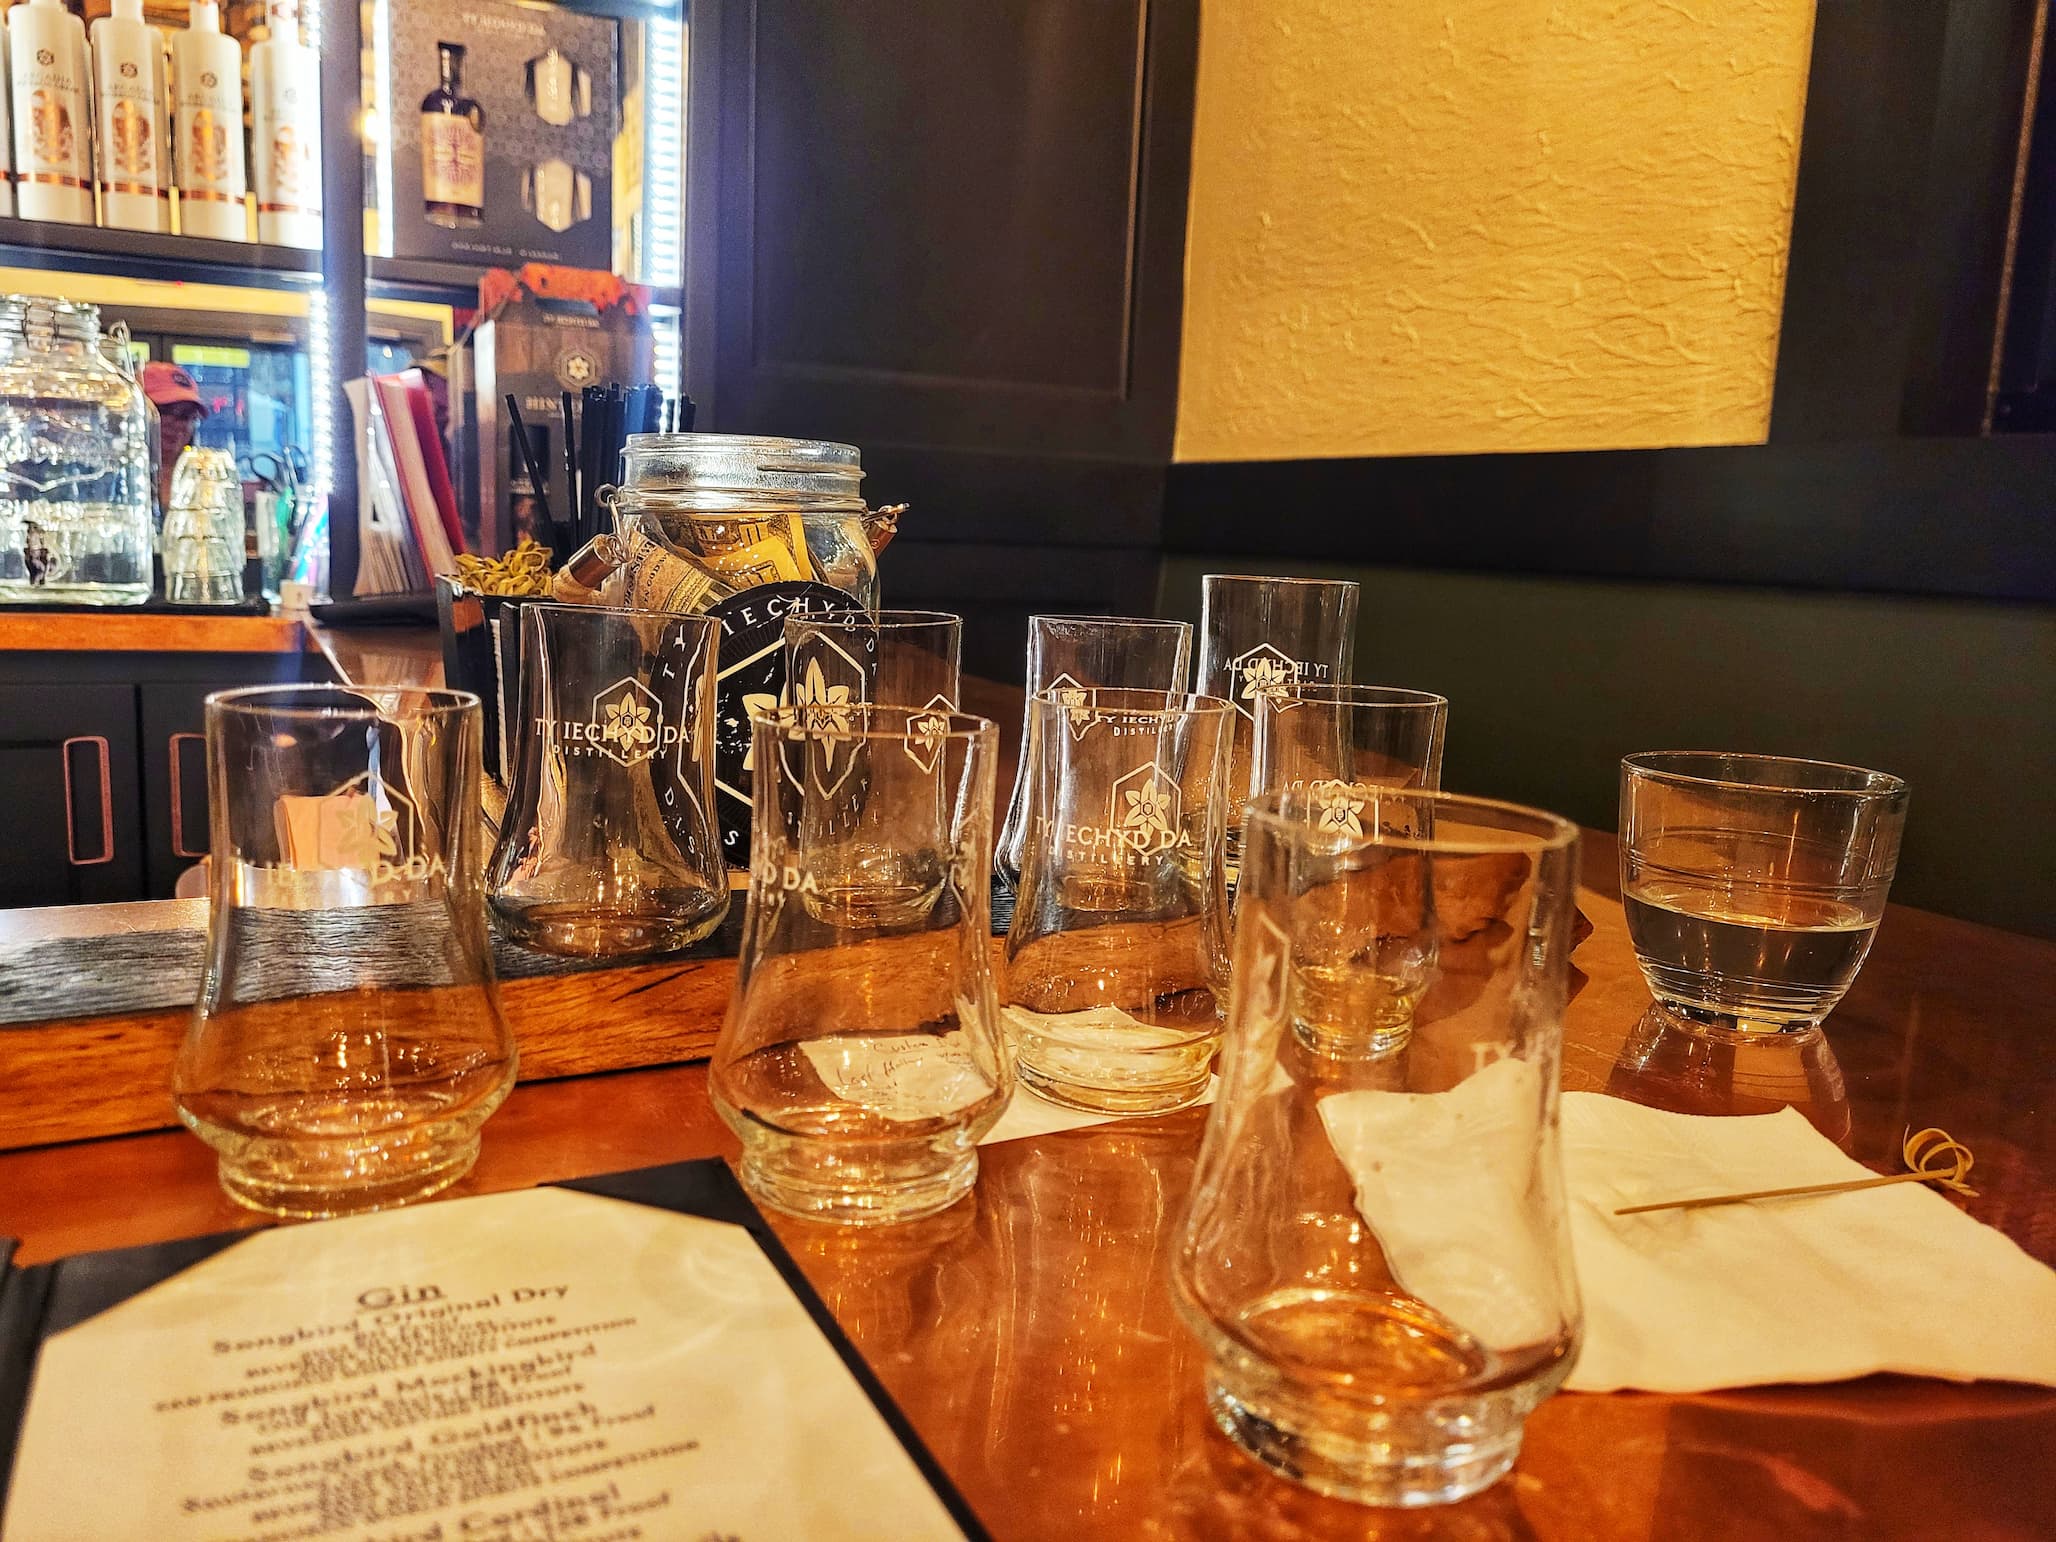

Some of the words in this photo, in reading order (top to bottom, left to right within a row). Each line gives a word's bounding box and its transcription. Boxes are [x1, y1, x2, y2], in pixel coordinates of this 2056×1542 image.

[563, 721, 657, 745] IECHYD
[662, 725, 692, 745] DA
[1159, 830, 1193, 851] DA
[356, 1284, 447, 1310] Gin
[212, 1317, 359, 1354] Songbird
[372, 1293, 501, 1326] Original
[511, 1283, 568, 1304] Dry
[219, 1384, 380, 1426] Songbird
[248, 1436, 414, 1483] Songbird
